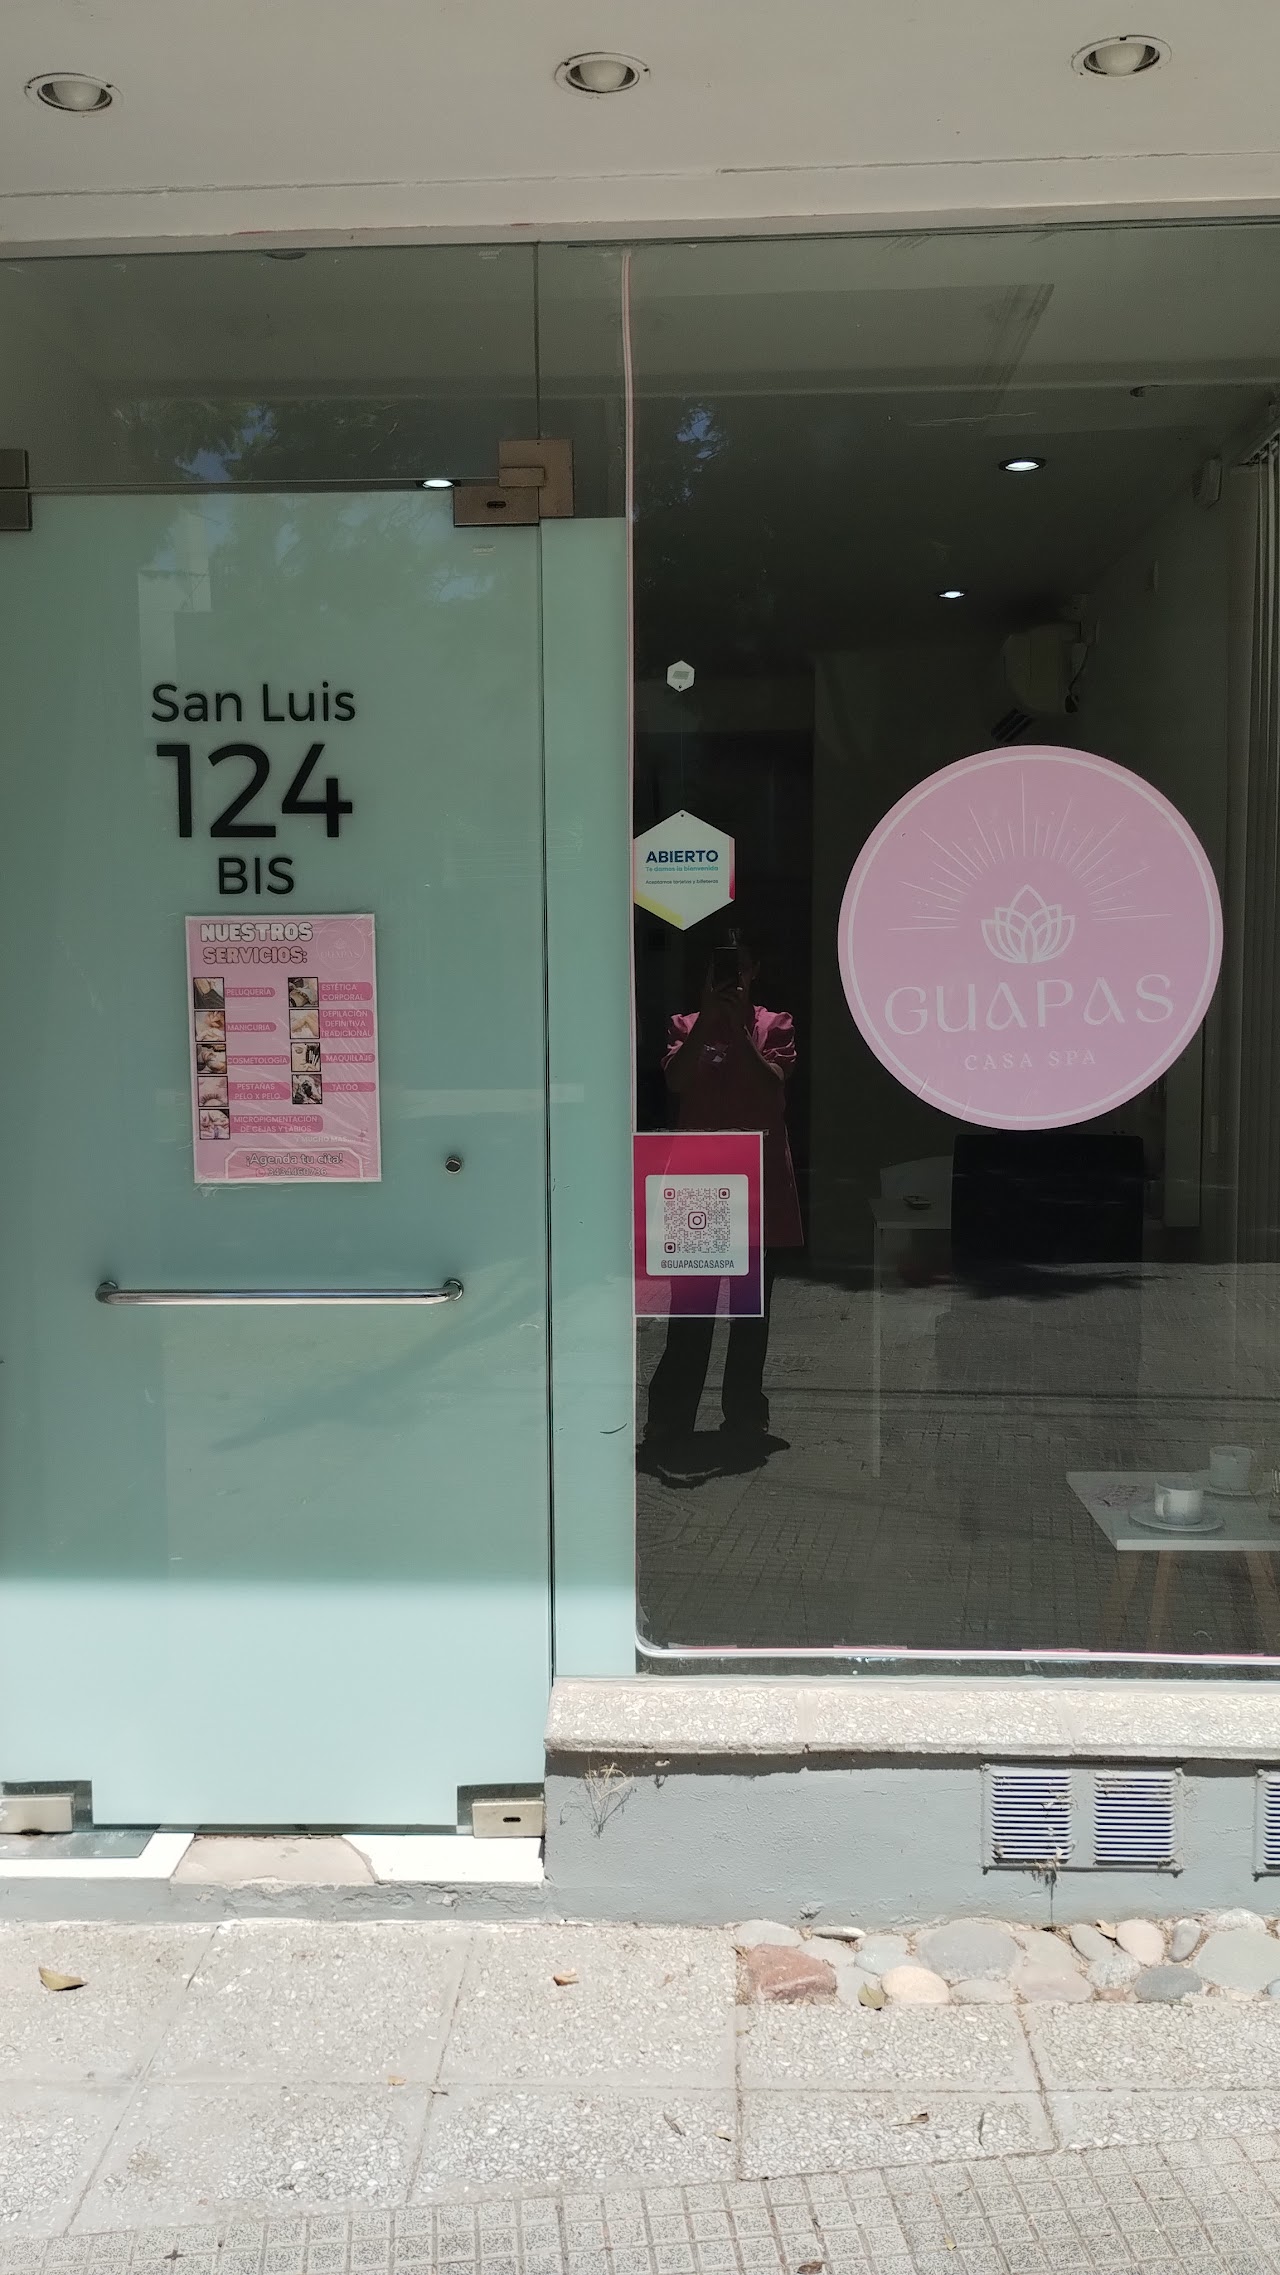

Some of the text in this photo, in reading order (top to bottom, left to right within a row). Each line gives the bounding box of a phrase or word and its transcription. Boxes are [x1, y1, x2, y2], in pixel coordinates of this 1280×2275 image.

[151, 681, 356, 722] San Luis
[156, 743, 353, 838] 124
[646, 850, 719, 863] ABIERTO
[218, 857, 295, 895] BIS
[200, 922, 313, 943] NUESTROS
[203, 946, 308, 964] SERVICIOS:
[321, 983, 358, 991] ESTÉTICA
[226, 988, 272, 997] PELUQUERÍA
[322, 993, 364, 1001] CORPORAL
[884, 974, 1175, 1036] GUAPAS
[322, 1009, 368, 1018] DEPILACIÓN
[321, 1029, 372, 1037] TRADICIONAL
[227, 1056, 288, 1065] COSMETOLOGÍA
[325, 1054, 373, 1063] MAQUILLAJE
[964, 1049, 1097, 1071] CASA SPA
[236, 1082, 276, 1090] PESTAÑAS
[332, 1083, 359, 1091] TATOO
[233, 1115, 318, 1123] MICROPIGMENTACIÓN
[246, 1153, 343, 1167] ¡Agenda tu cita!
[660, 1259, 735, 1269] @GUAPASCASASPA
